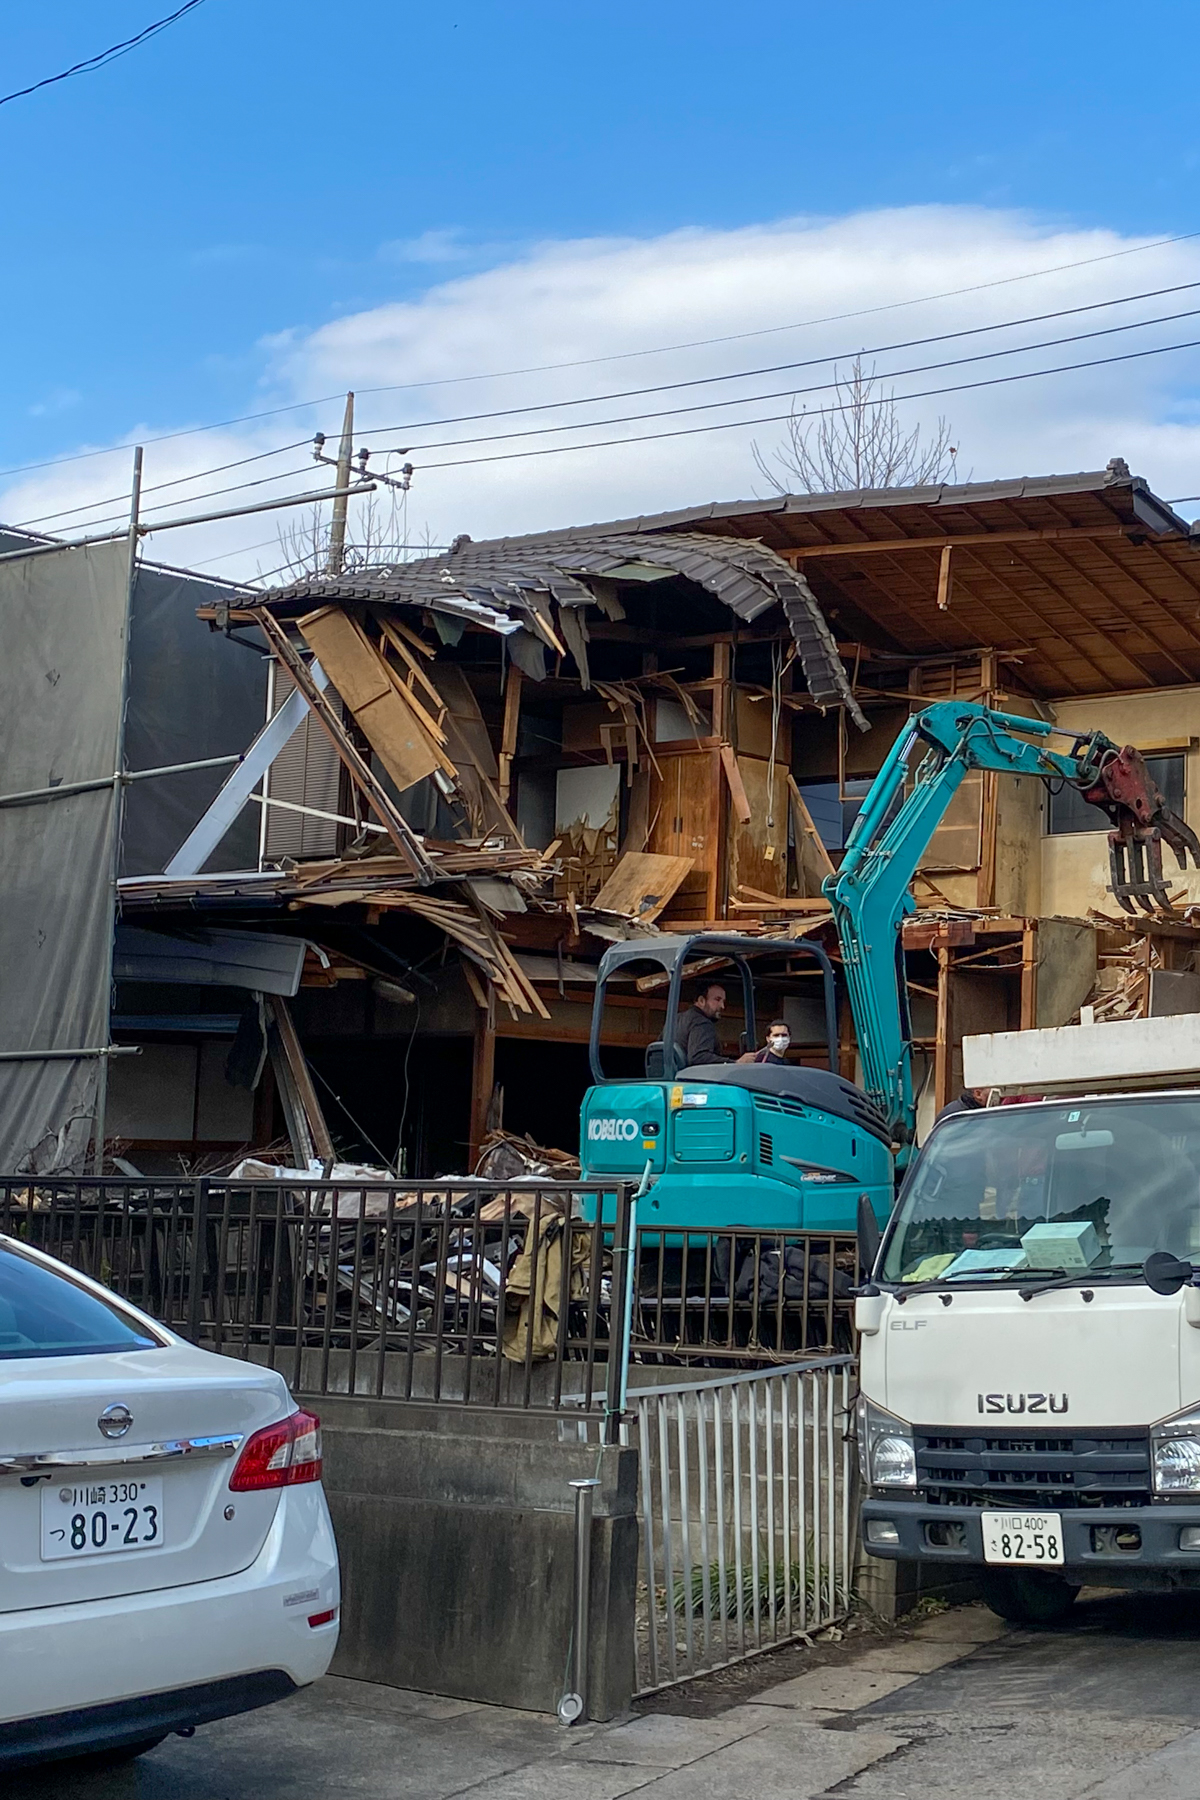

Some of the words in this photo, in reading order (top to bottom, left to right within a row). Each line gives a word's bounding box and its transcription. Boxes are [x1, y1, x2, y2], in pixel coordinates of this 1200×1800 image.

[588, 1118, 639, 1141] KOBELCO
[890, 1320, 928, 1331] ELF
[977, 1393, 1069, 1414] ISUZU
[73, 1486, 106, 1507] 川崎
[109, 1482, 138, 1504] 330
[71, 1505, 157, 1550] 80-23
[1000, 1517, 1022, 1530] 川口
[1024, 1517, 1044, 1531] 400
[1001, 1533, 1059, 1560] 82-58
